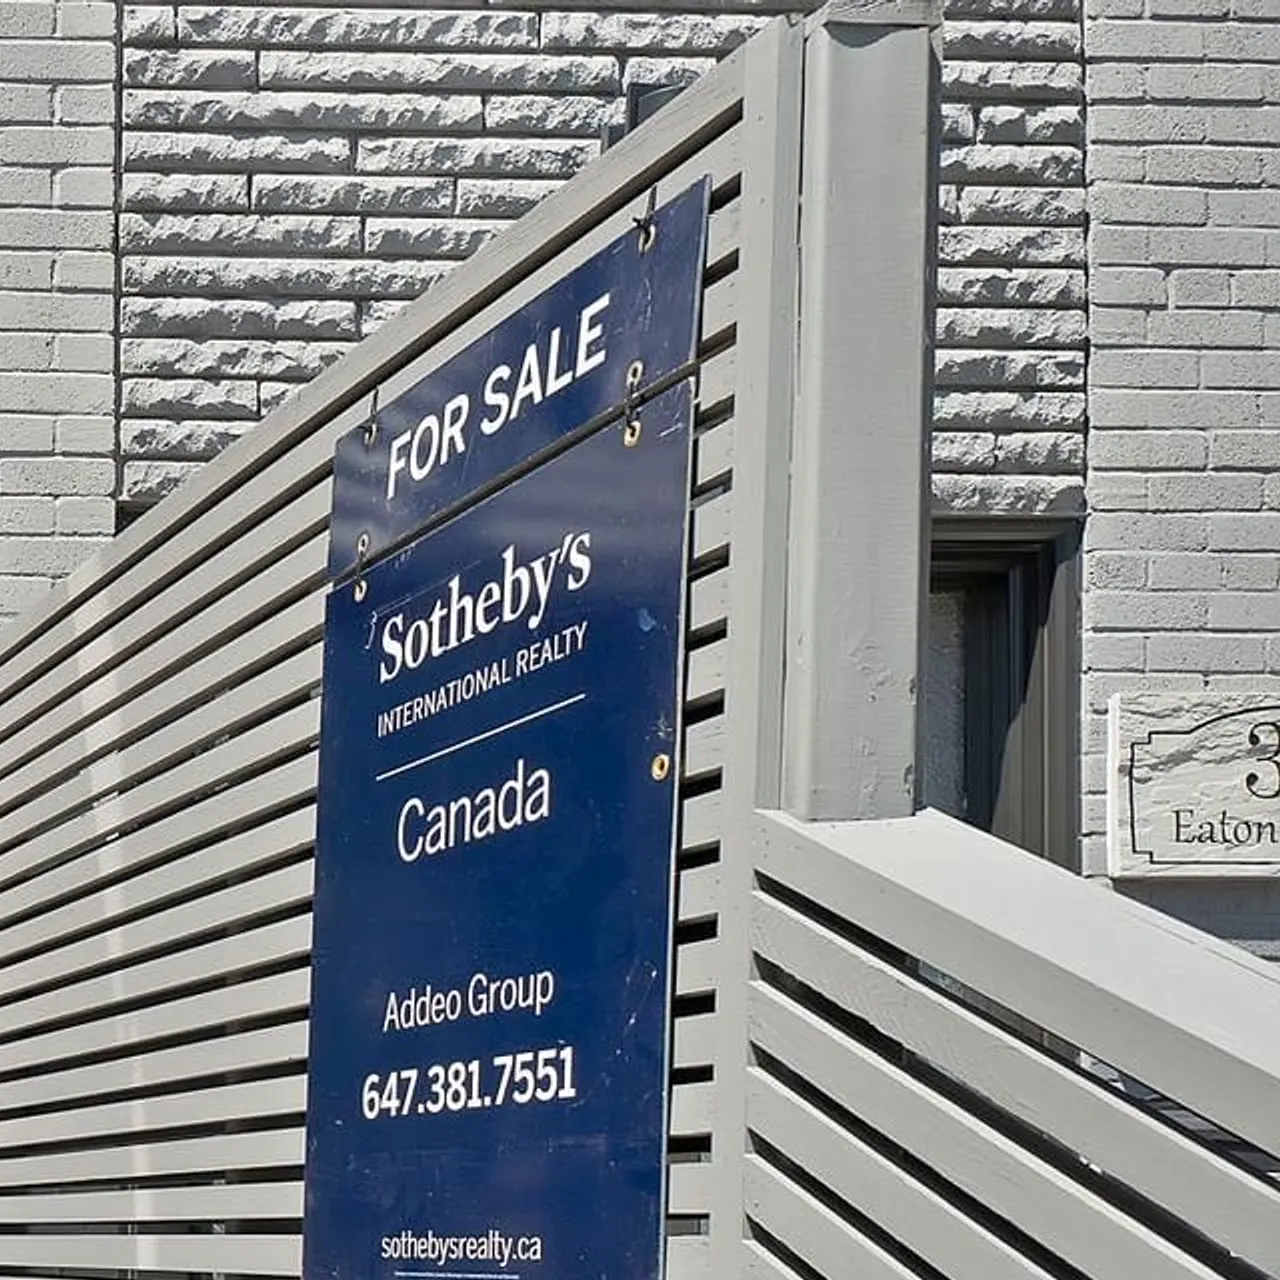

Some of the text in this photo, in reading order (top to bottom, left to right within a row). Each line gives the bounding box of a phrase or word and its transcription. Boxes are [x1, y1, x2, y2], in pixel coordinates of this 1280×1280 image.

[386, 292, 611, 500] FOR SALE
[380, 531, 592, 684] Sotheby's
[377, 620, 588, 738] INTERNATIONAL REALTY
[397, 757, 550, 863] Canada
[1171, 809, 1278, 844] Eaton
[383, 970, 554, 1032] Addeo Group
[361, 1046, 577, 1120] 647.381.7551
[381, 1230, 542, 1267] sothebysrealty.ca
